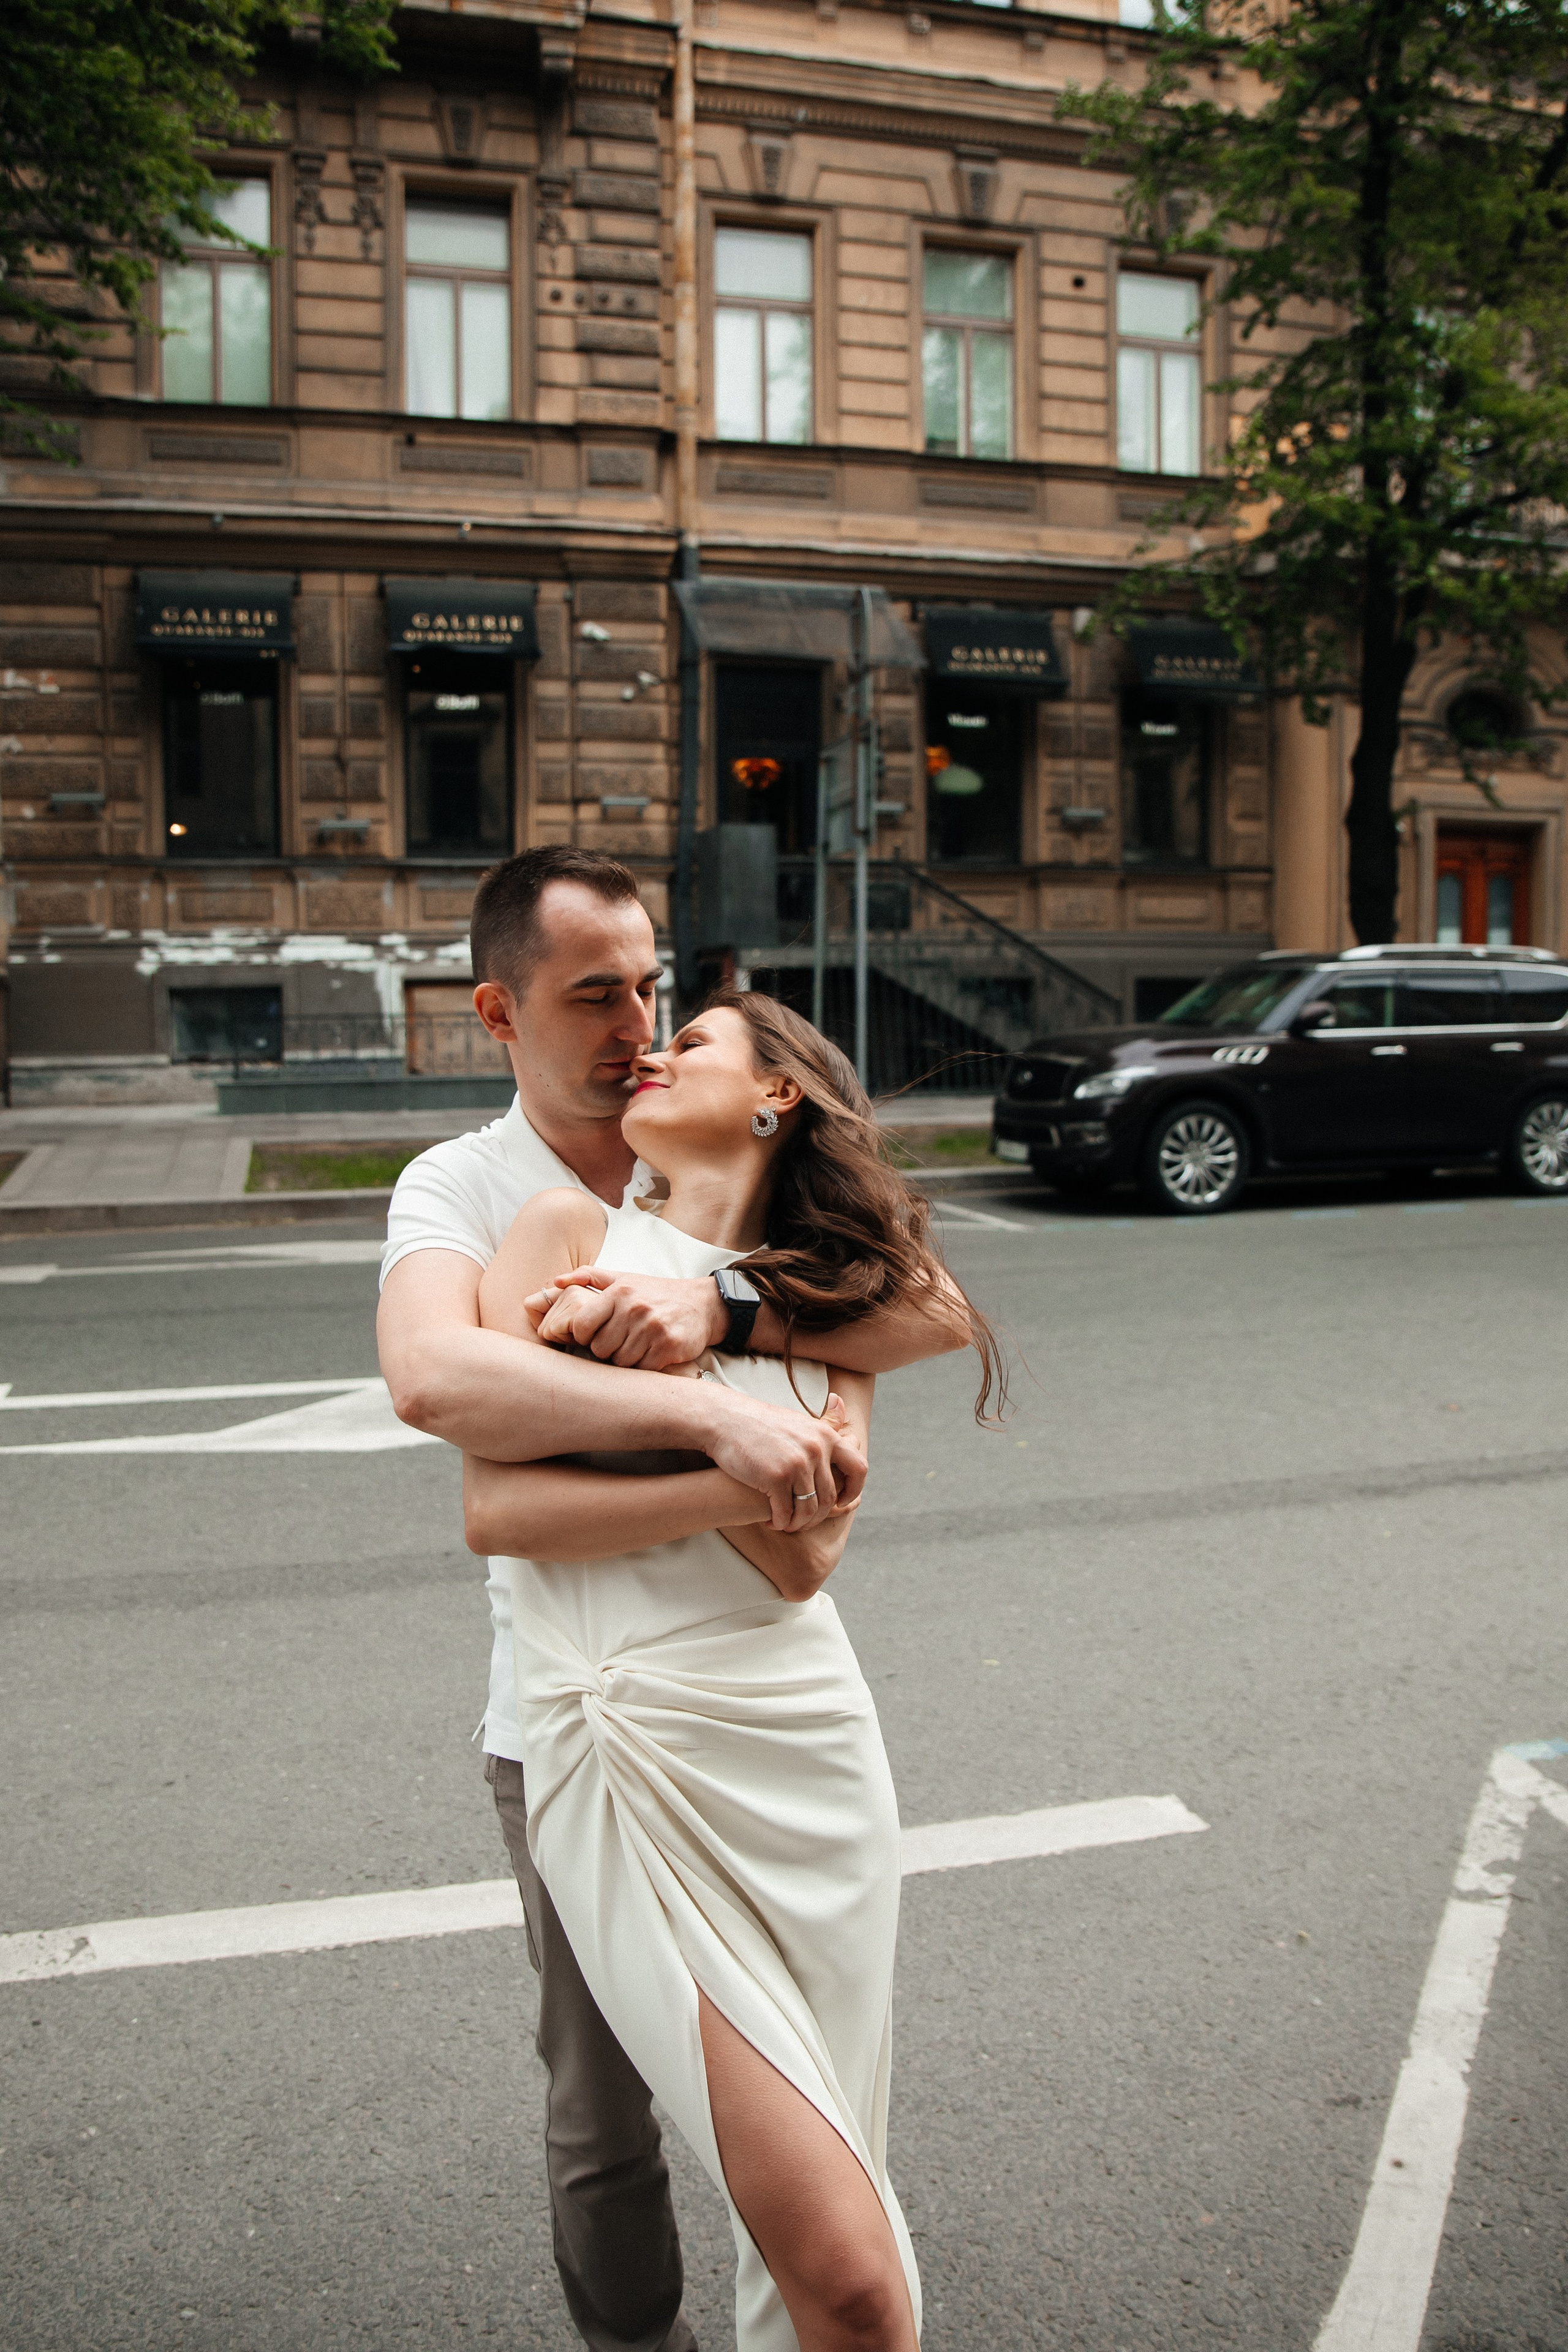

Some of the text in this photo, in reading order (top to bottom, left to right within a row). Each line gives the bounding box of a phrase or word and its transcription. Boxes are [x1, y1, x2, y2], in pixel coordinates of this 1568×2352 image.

[161, 606, 278, 626] GALERIE
[411, 612, 524, 631] GALERIE
[951, 646, 1049, 665] GALERIE
